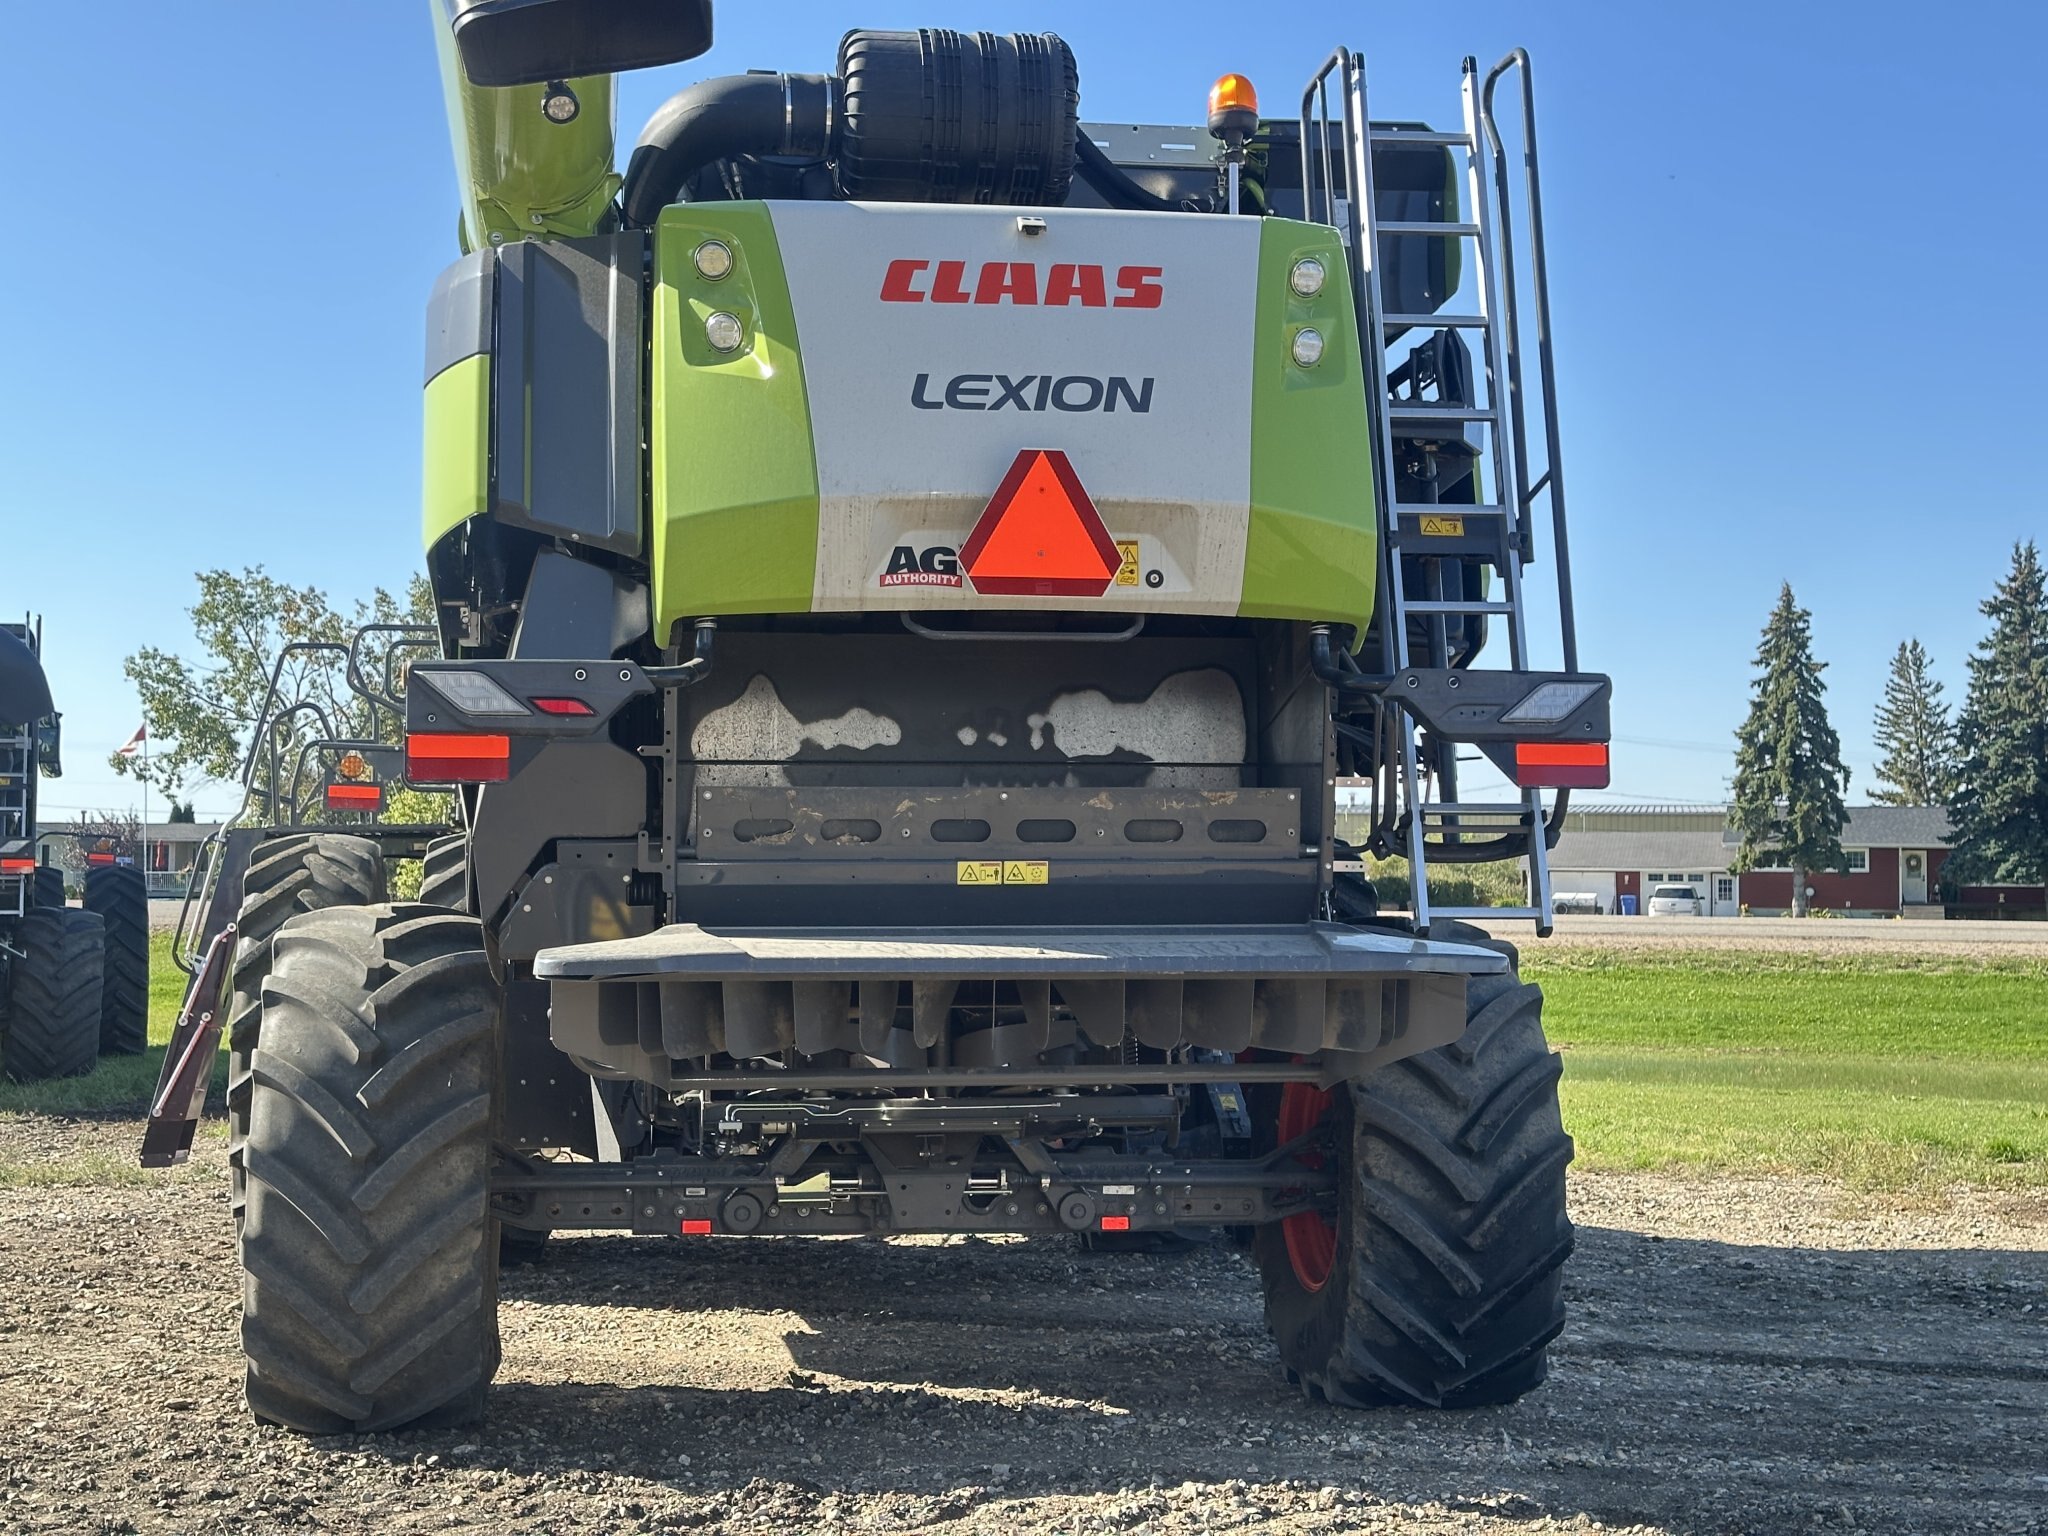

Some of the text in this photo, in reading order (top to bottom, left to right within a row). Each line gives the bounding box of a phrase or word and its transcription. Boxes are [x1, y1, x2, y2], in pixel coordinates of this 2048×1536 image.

[880, 259, 1163, 309] CLAAS
[911, 373, 1155, 413] LEXION
[886, 546, 959, 575] AG
[884, 573, 959, 585] AUTHORITY
